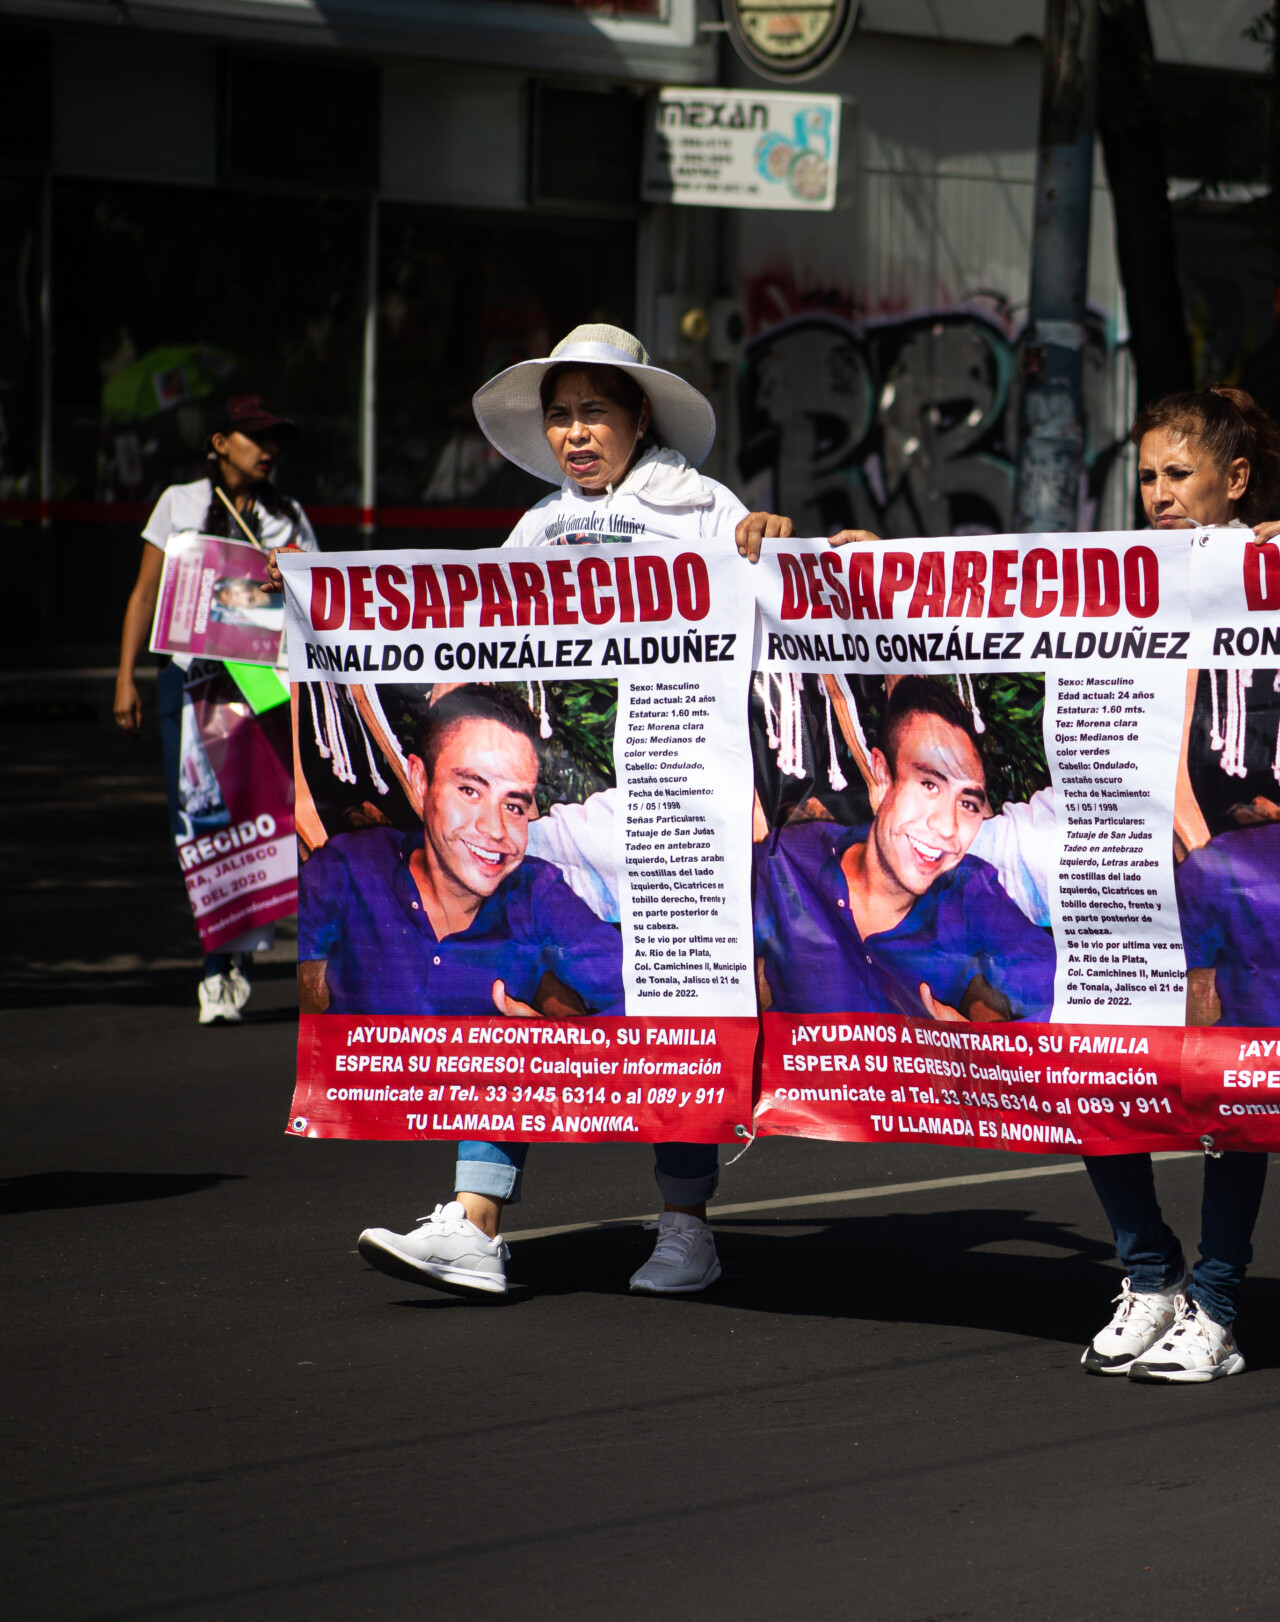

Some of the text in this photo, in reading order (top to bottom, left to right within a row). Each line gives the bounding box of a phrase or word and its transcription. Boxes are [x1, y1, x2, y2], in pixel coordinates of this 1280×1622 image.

[566, 510, 605, 532] Gonzalez
[607, 514, 646, 534] Alduñez
[310, 552, 710, 634] DESAPARECIDO
[777, 546, 1159, 620] DESAPARECIDO
[305, 629, 736, 672] RONALDO GONZÁLEZ ALDUÑEZ
[768, 626, 1190, 662] RONALDO GONZÁLEZ ALDUÑEZ
[656, 682, 699, 690] Masculino
[630, 697, 651, 705] Edad
[654, 696, 682, 704] actual:
[626, 737, 647, 746] Ojos:
[1067, 831, 1152, 840] Tatuaje de San Judas
[215, 845, 278, 878] JALISCO
[201, 870, 267, 907] DEL 2020
[347, 1027, 716, 1048] ¡AYUDANOS A ENCONTRARLO, SU FAMILIA
[336, 1055, 721, 1078] ESPERA SU REGRESO! Cualquier información
[407, 1114, 638, 1132] TU LLAMADA ES ANONIMA.
[871, 1115, 1082, 1144] TU LLAMADA ES ANONIMA.
